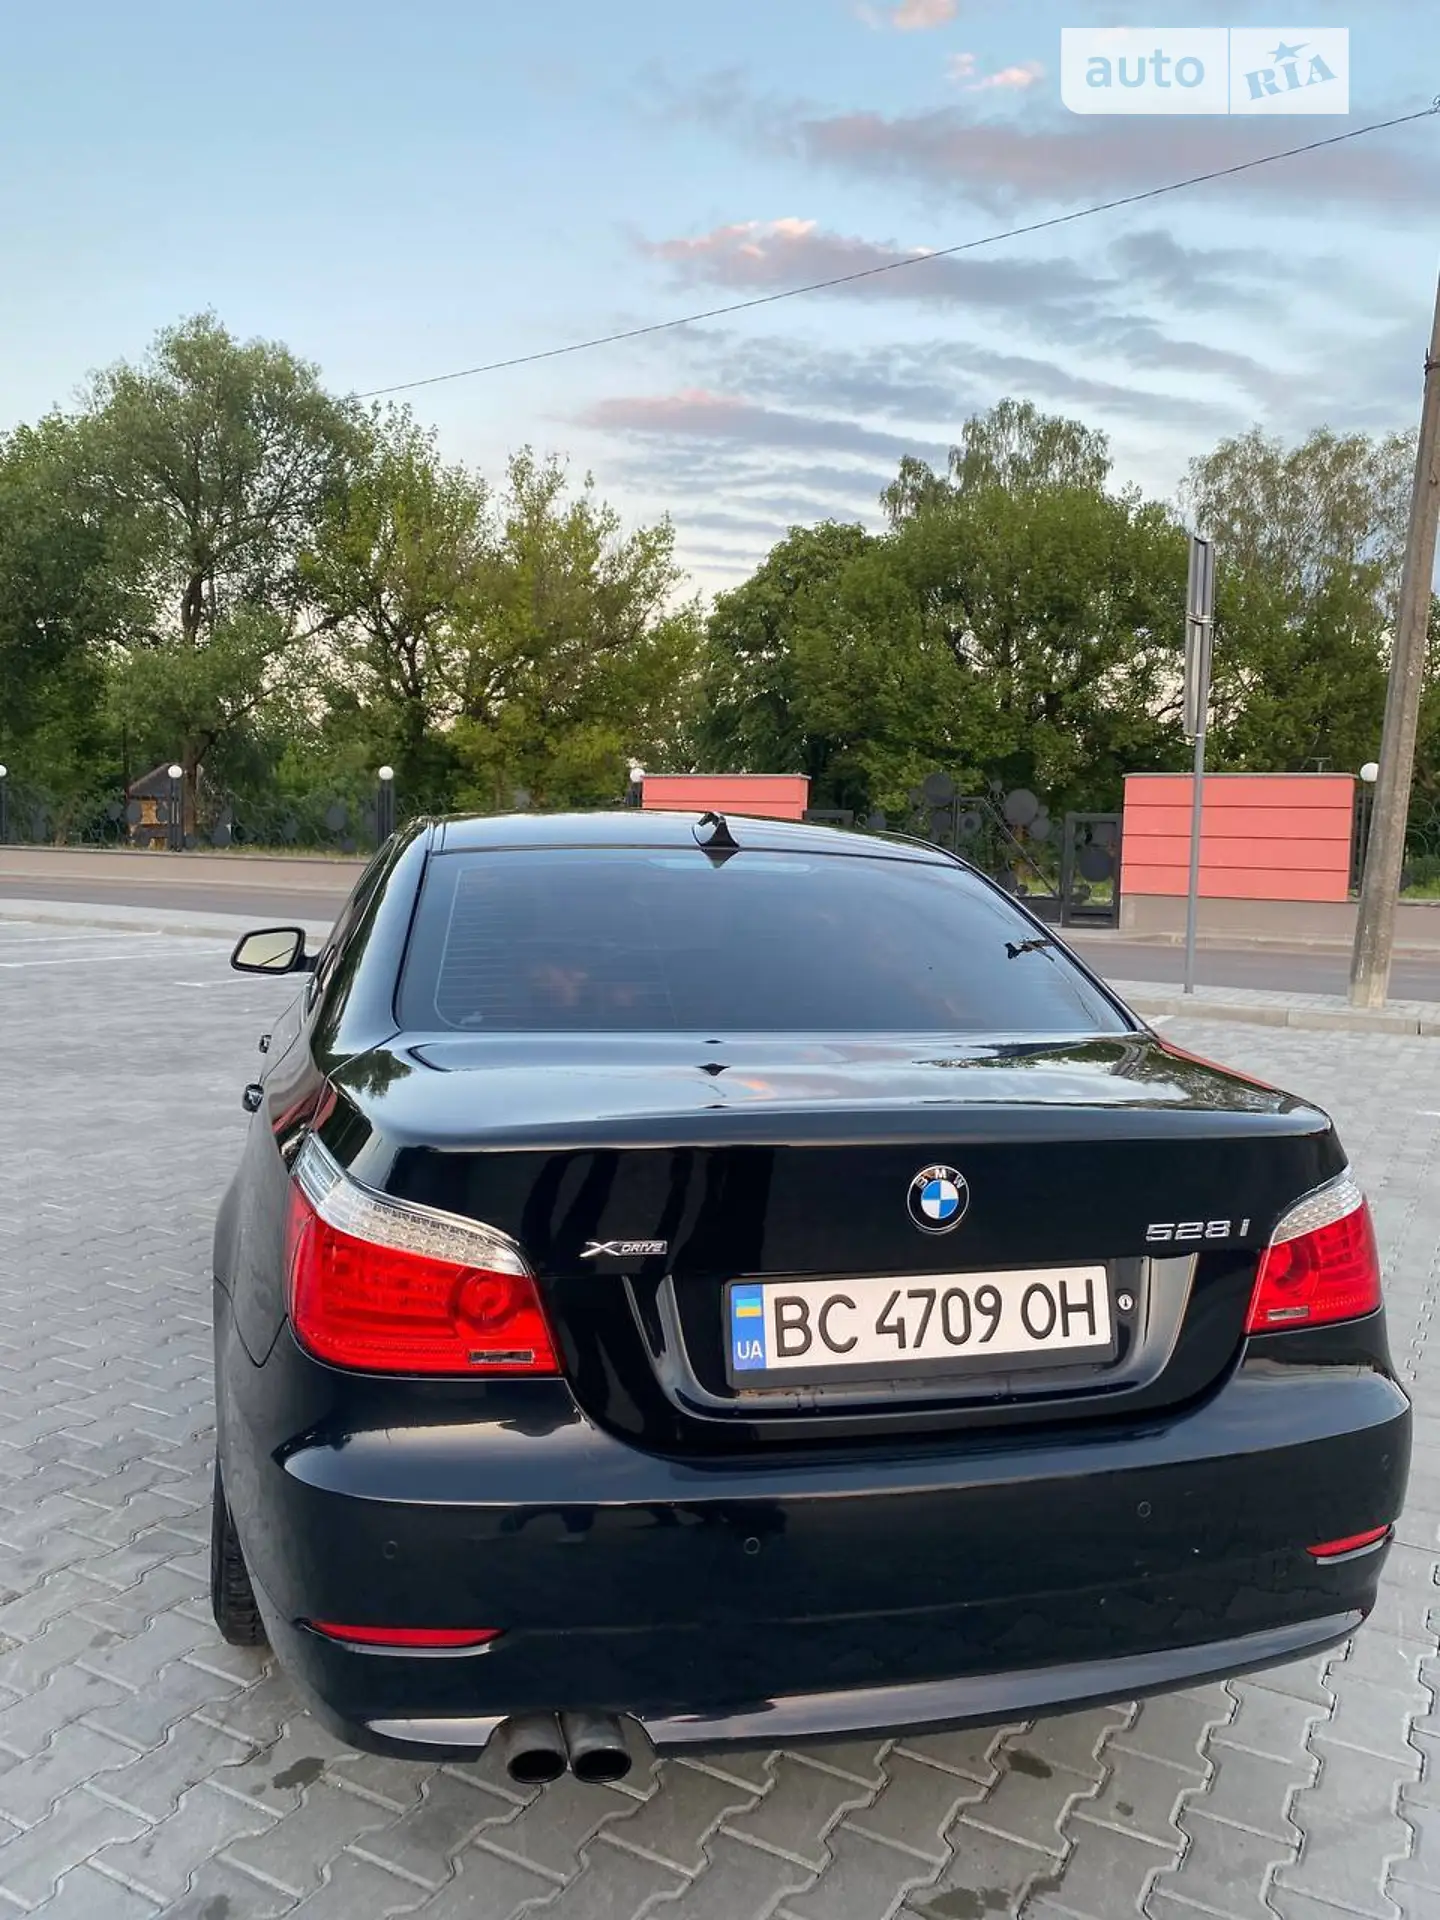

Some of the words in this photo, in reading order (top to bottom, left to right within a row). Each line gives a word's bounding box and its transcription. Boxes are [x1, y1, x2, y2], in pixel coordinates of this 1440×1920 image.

[914, 1168, 967, 1190] BMW
[774, 1293, 859, 1358] BC
[875, 1284, 1003, 1349] 4709
[1020, 1278, 1097, 1340] OH
[737, 1340, 764, 1359] UA
